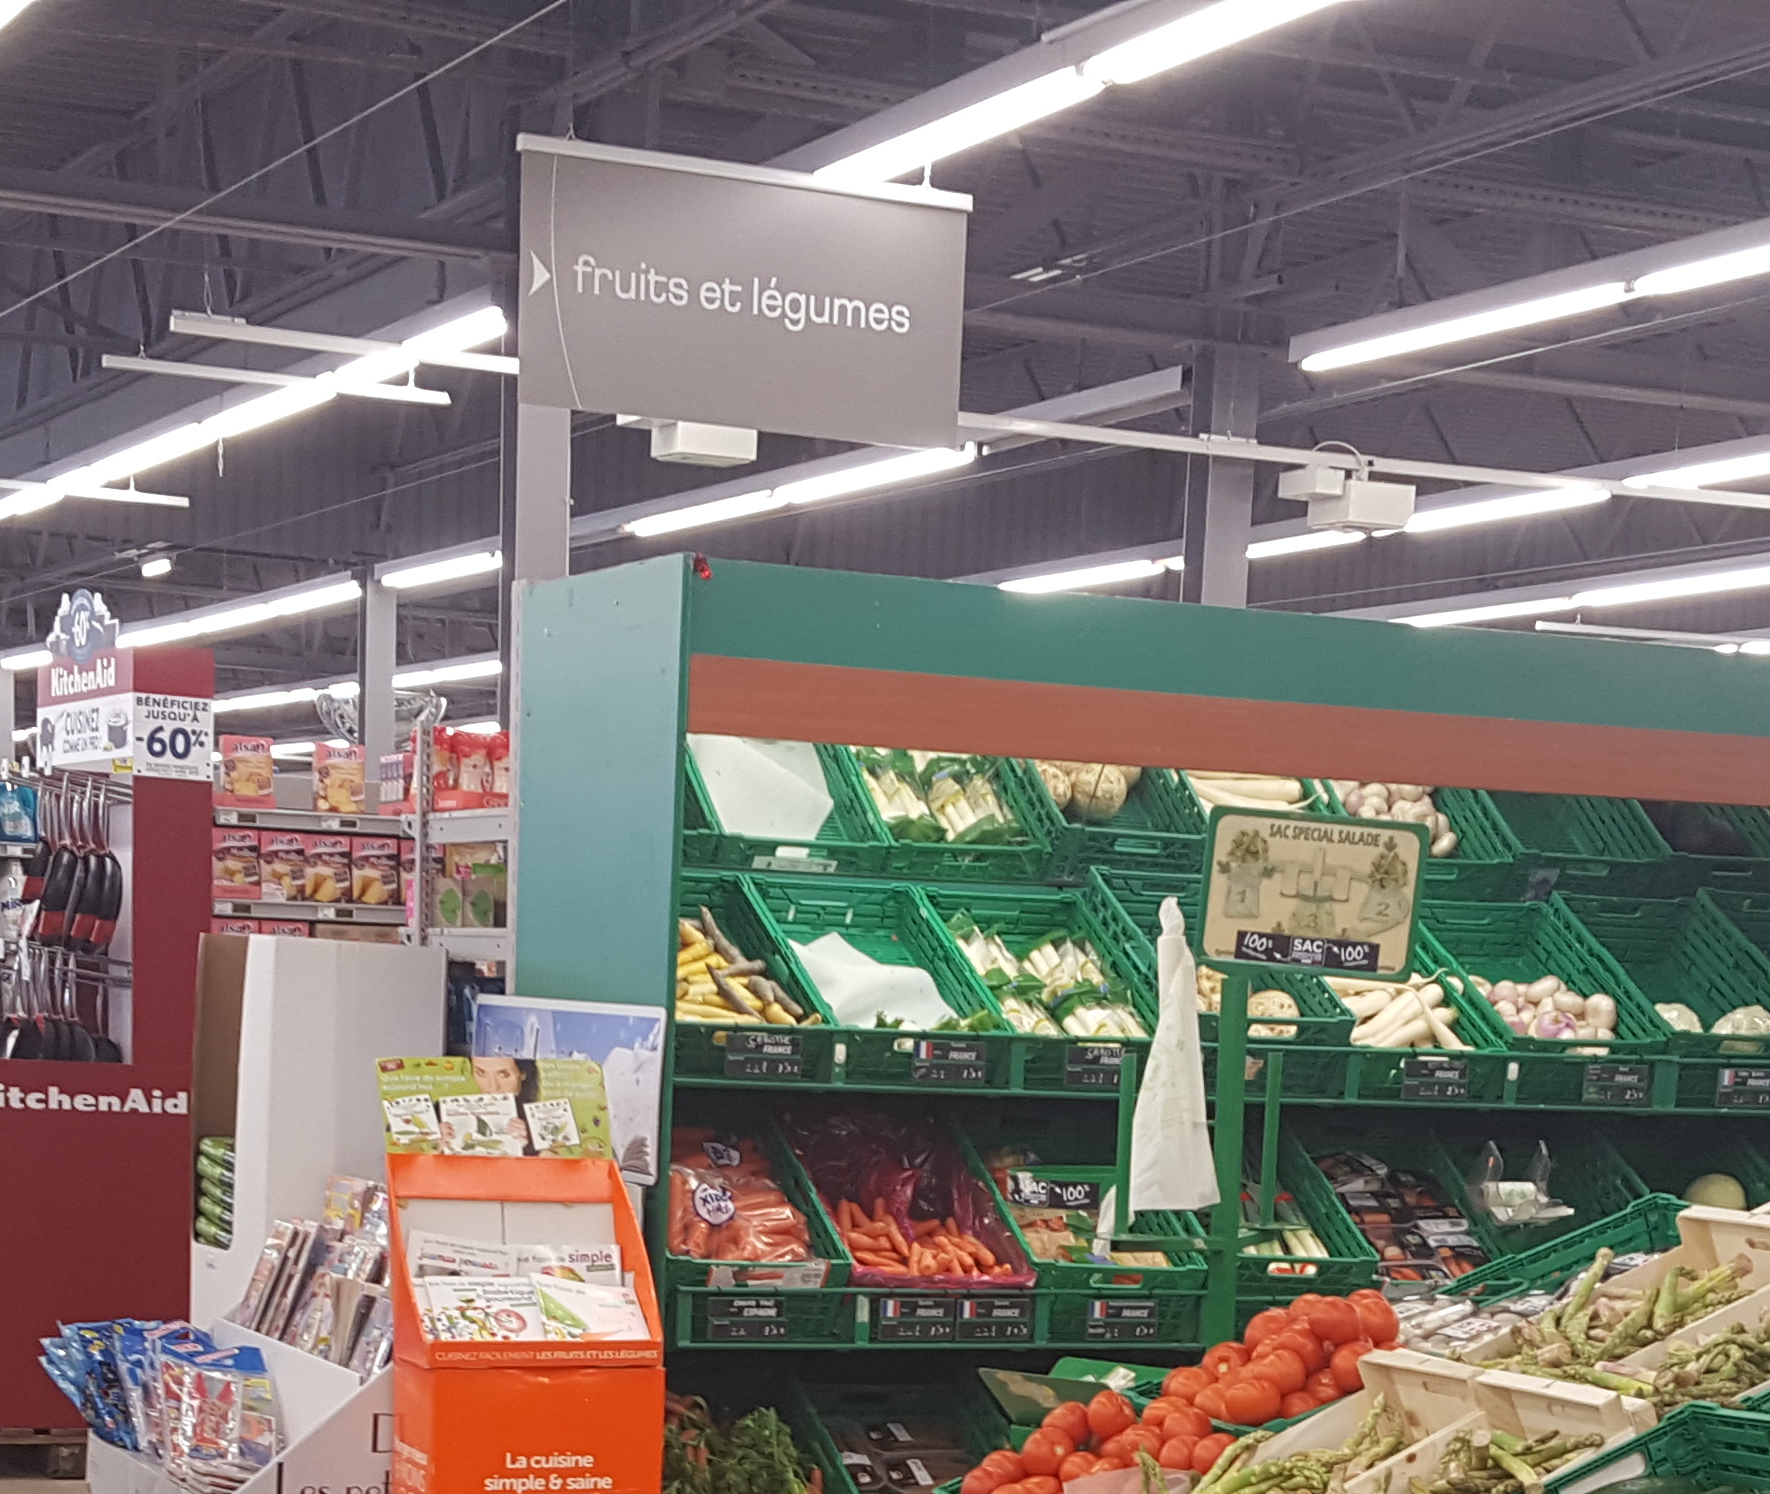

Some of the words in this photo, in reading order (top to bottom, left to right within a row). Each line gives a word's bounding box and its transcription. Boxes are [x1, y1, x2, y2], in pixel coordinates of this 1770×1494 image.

[573, 254, 689, 306] fruits
[700, 277, 742, 312] et
[753, 277, 910, 333] légumes
[51, 657, 115, 697] KitchenAid
[136, 696, 209, 712] BÉNÉFICIEZ
[145, 709, 200, 723] JUSQU'À
[1269, 824, 1291, 838] SAC
[1292, 825, 1334, 843] SPECIAL
[1337, 830, 1381, 847] SALADE
[1293, 939, 1323, 953] SAC
[569, 1250, 613, 1269] simple
[505, 1452, 529, 1470] La
[530, 1452, 595, 1469] cuisine
[484, 1475, 547, 1494] simple
[548, 1474, 564, 1490] &
[565, 1474, 613, 1490] saine
